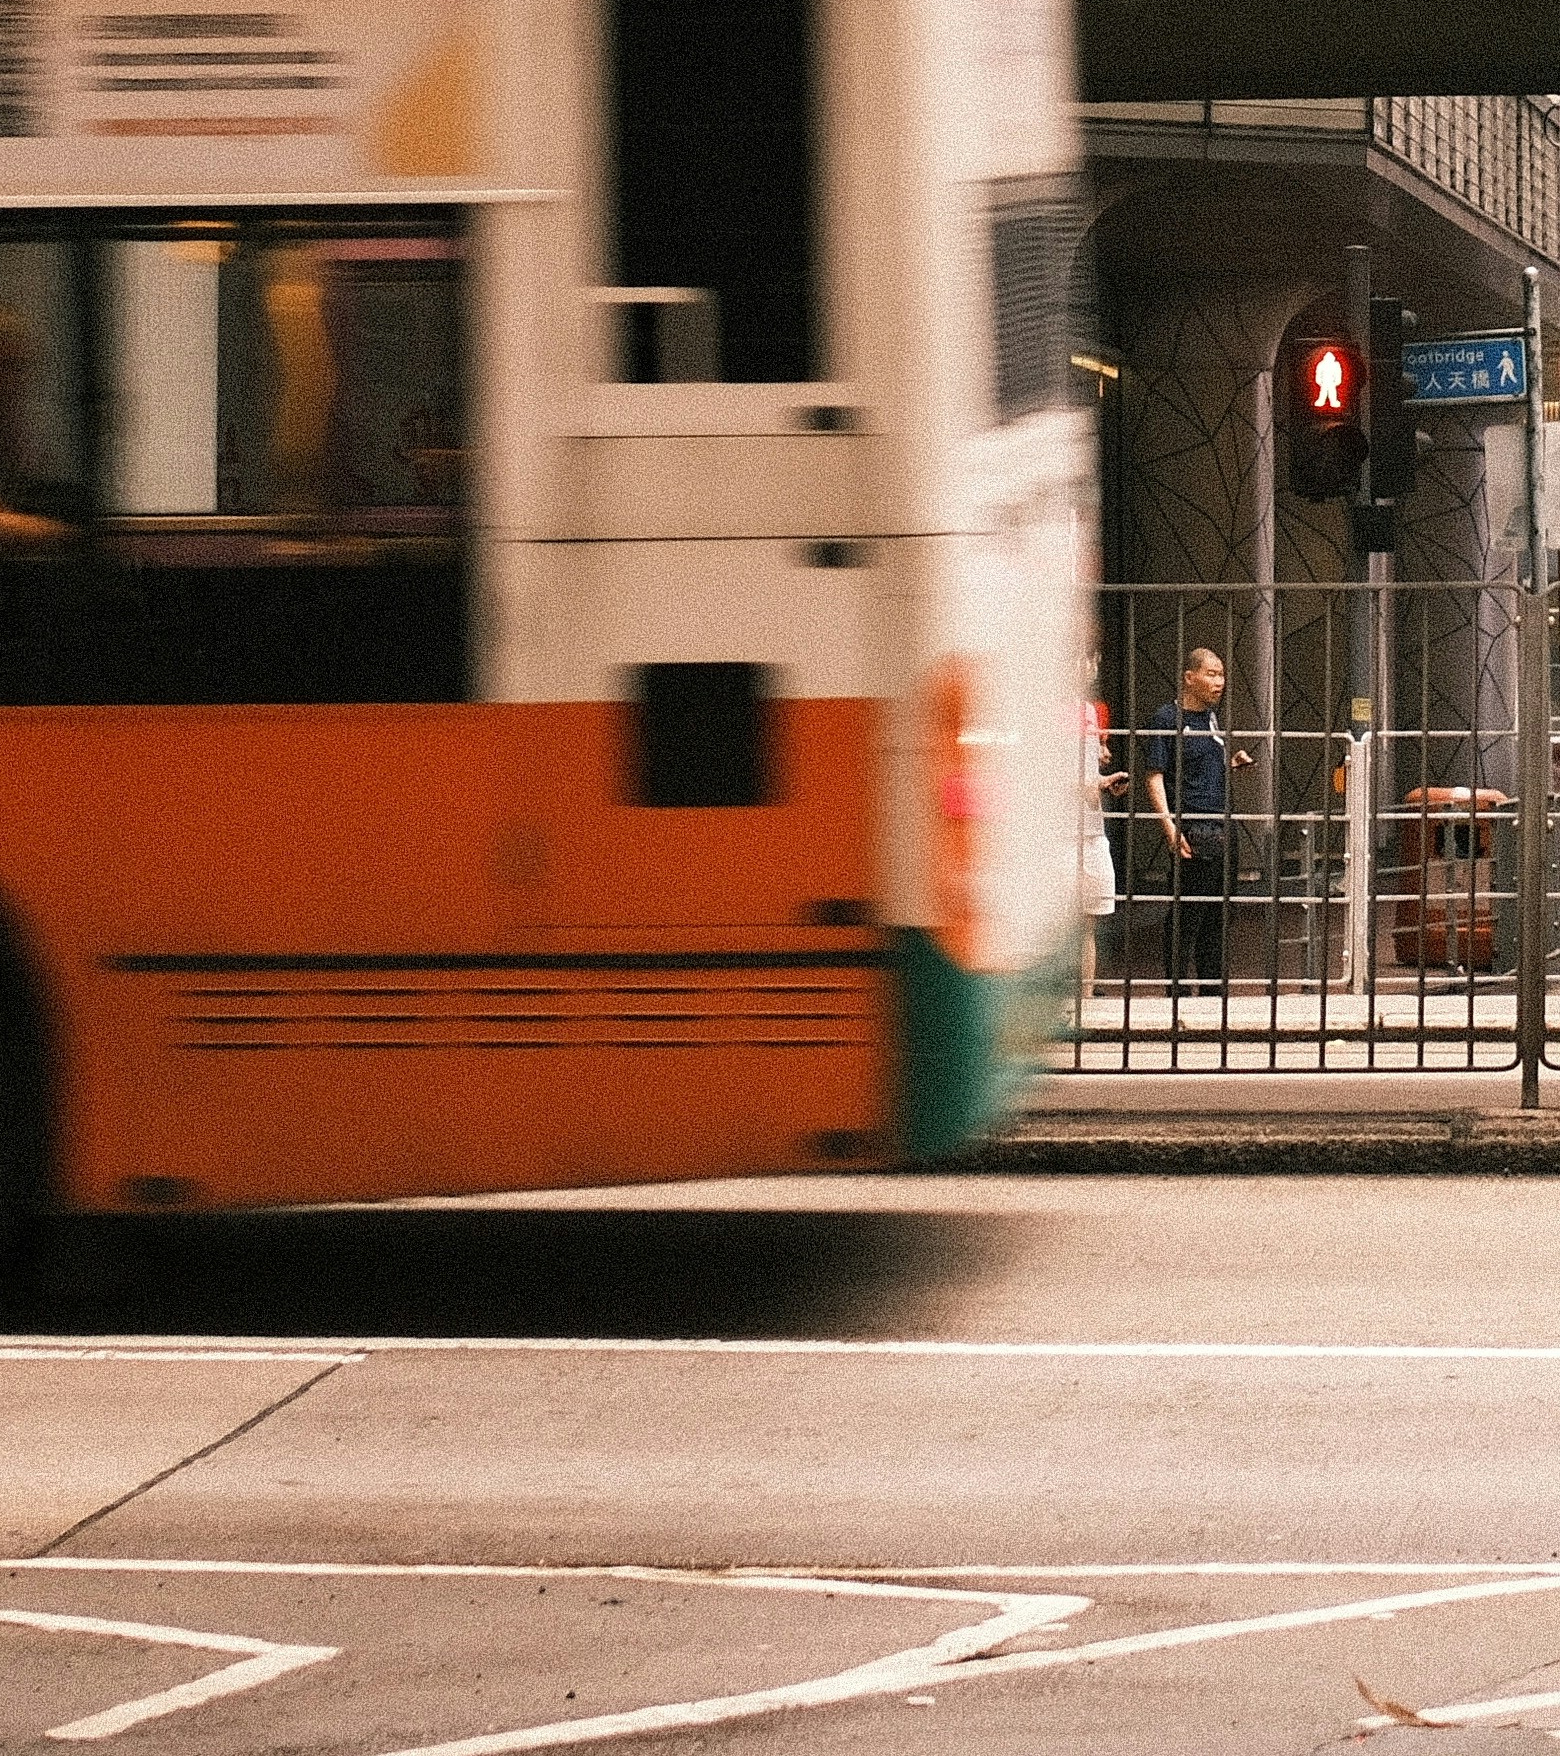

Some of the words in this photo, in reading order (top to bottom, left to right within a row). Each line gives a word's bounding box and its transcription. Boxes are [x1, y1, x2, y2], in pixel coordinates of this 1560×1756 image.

[1405, 349, 1485, 365] ootbridge
[1421, 369, 1490, 391] 人天橋
